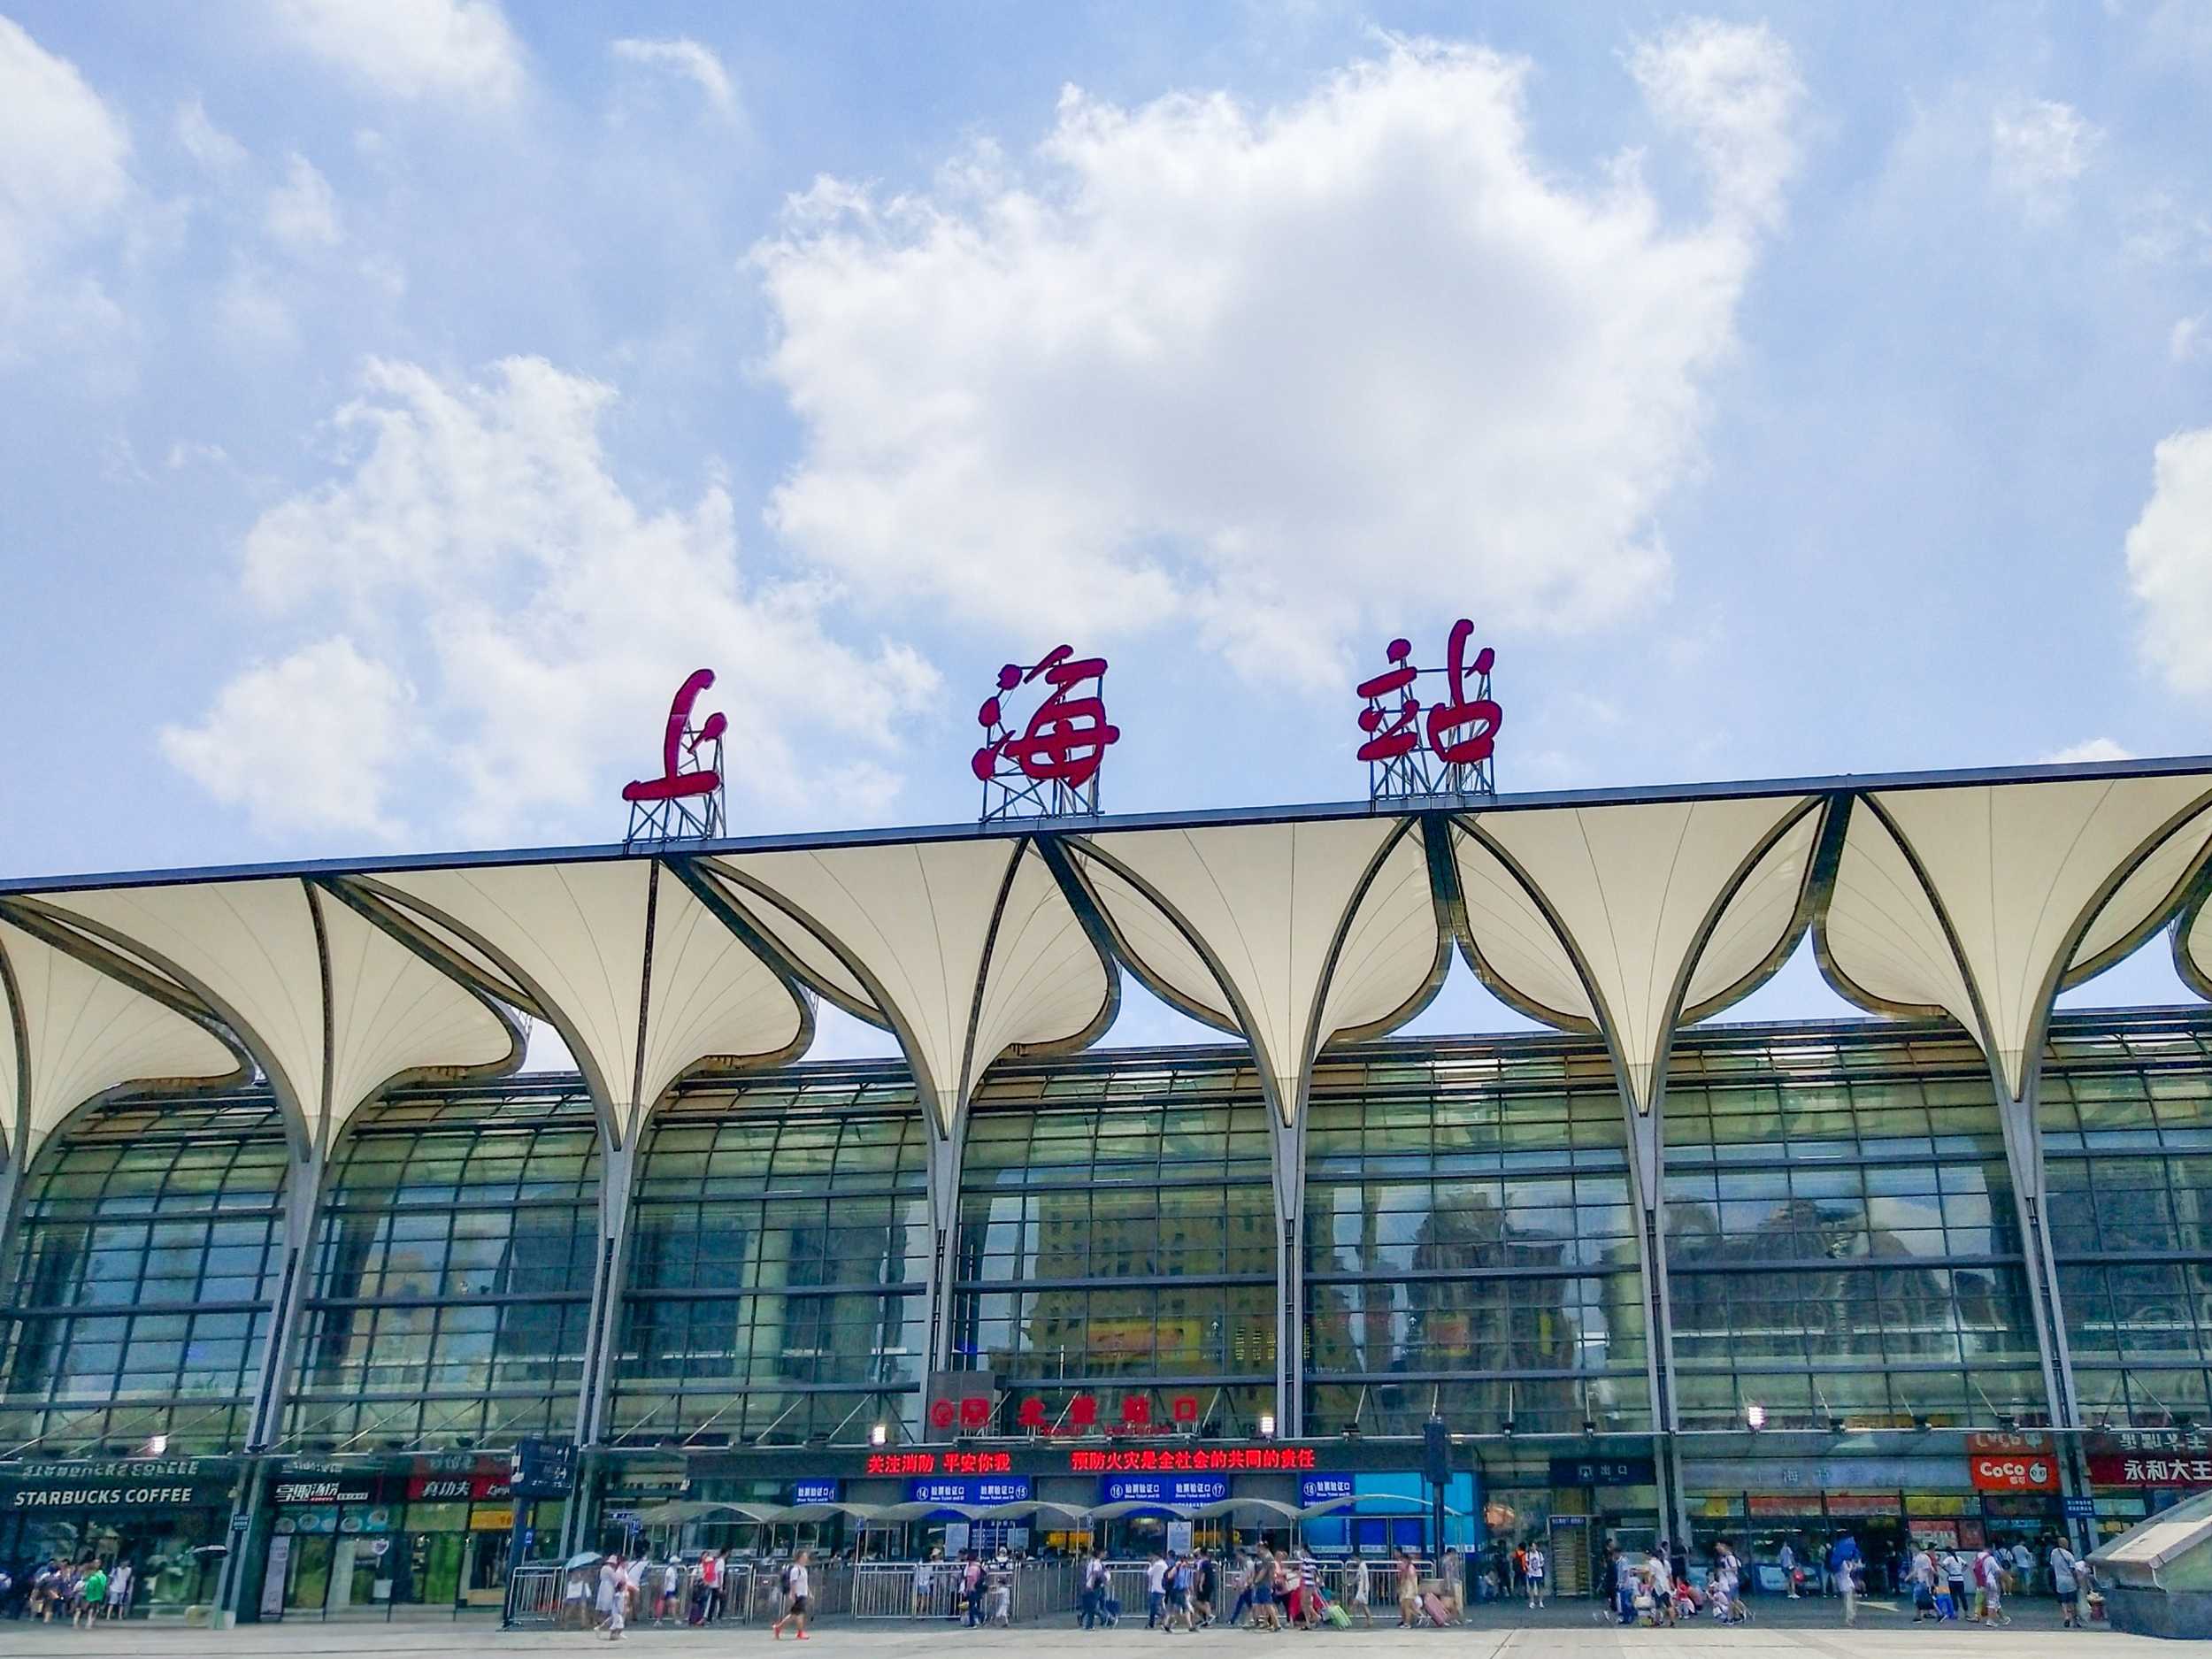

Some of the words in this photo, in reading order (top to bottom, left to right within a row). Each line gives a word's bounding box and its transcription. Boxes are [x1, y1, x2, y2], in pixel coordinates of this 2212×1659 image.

[622, 618, 1502, 801] 上海站
[868, 1453, 935, 1473] 关注消防
[943, 1451, 1011, 1472] 平安你我
[1071, 1448, 1315, 1471] 预防火灾是全社会的共同的责任
[2124, 1458, 2212, 1481] 永和大王
[14, 1489, 121, 1506] STARBUCKS
[125, 1487, 193, 1503] COFFEE
[422, 1480, 471, 1497] 真功夫
